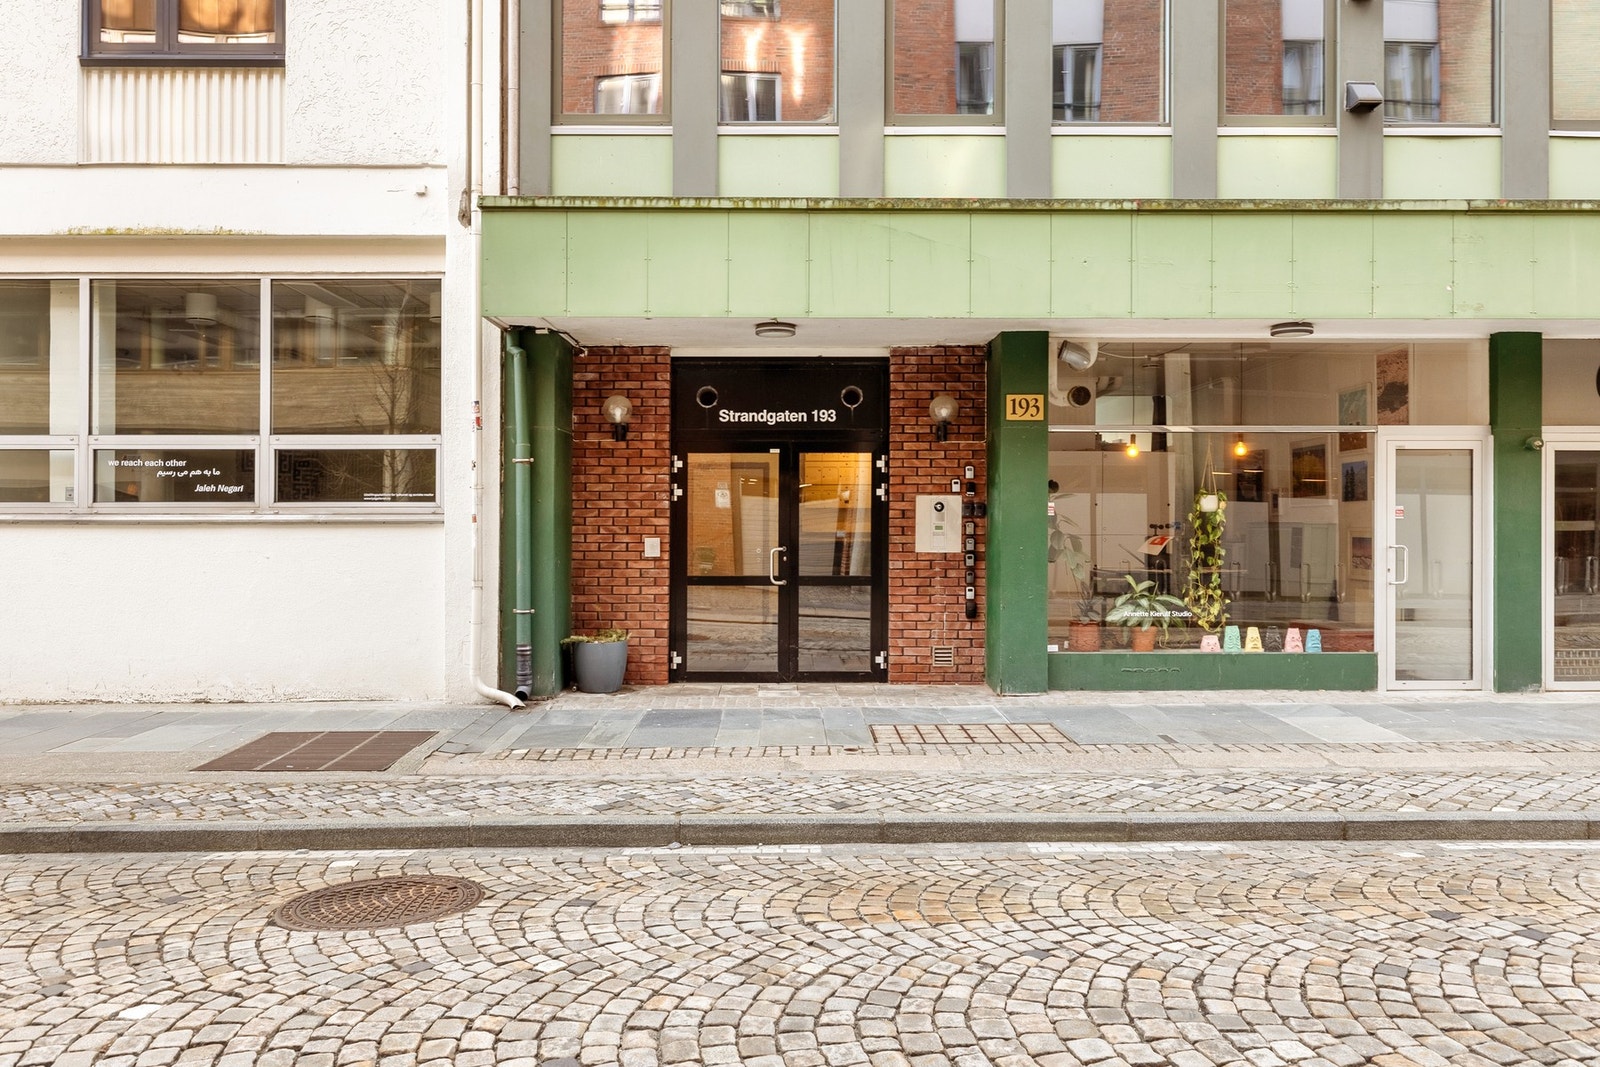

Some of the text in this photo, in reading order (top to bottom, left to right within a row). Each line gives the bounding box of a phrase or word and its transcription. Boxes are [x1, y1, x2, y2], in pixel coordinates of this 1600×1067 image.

[1010, 397, 1041, 418] 193
[718, 409, 837, 425] Strandgaten 193
[121, 459, 143, 467] reach
[144, 459, 164, 467] each
[165, 459, 187, 467] other
[194, 484, 216, 493] Jaleh
